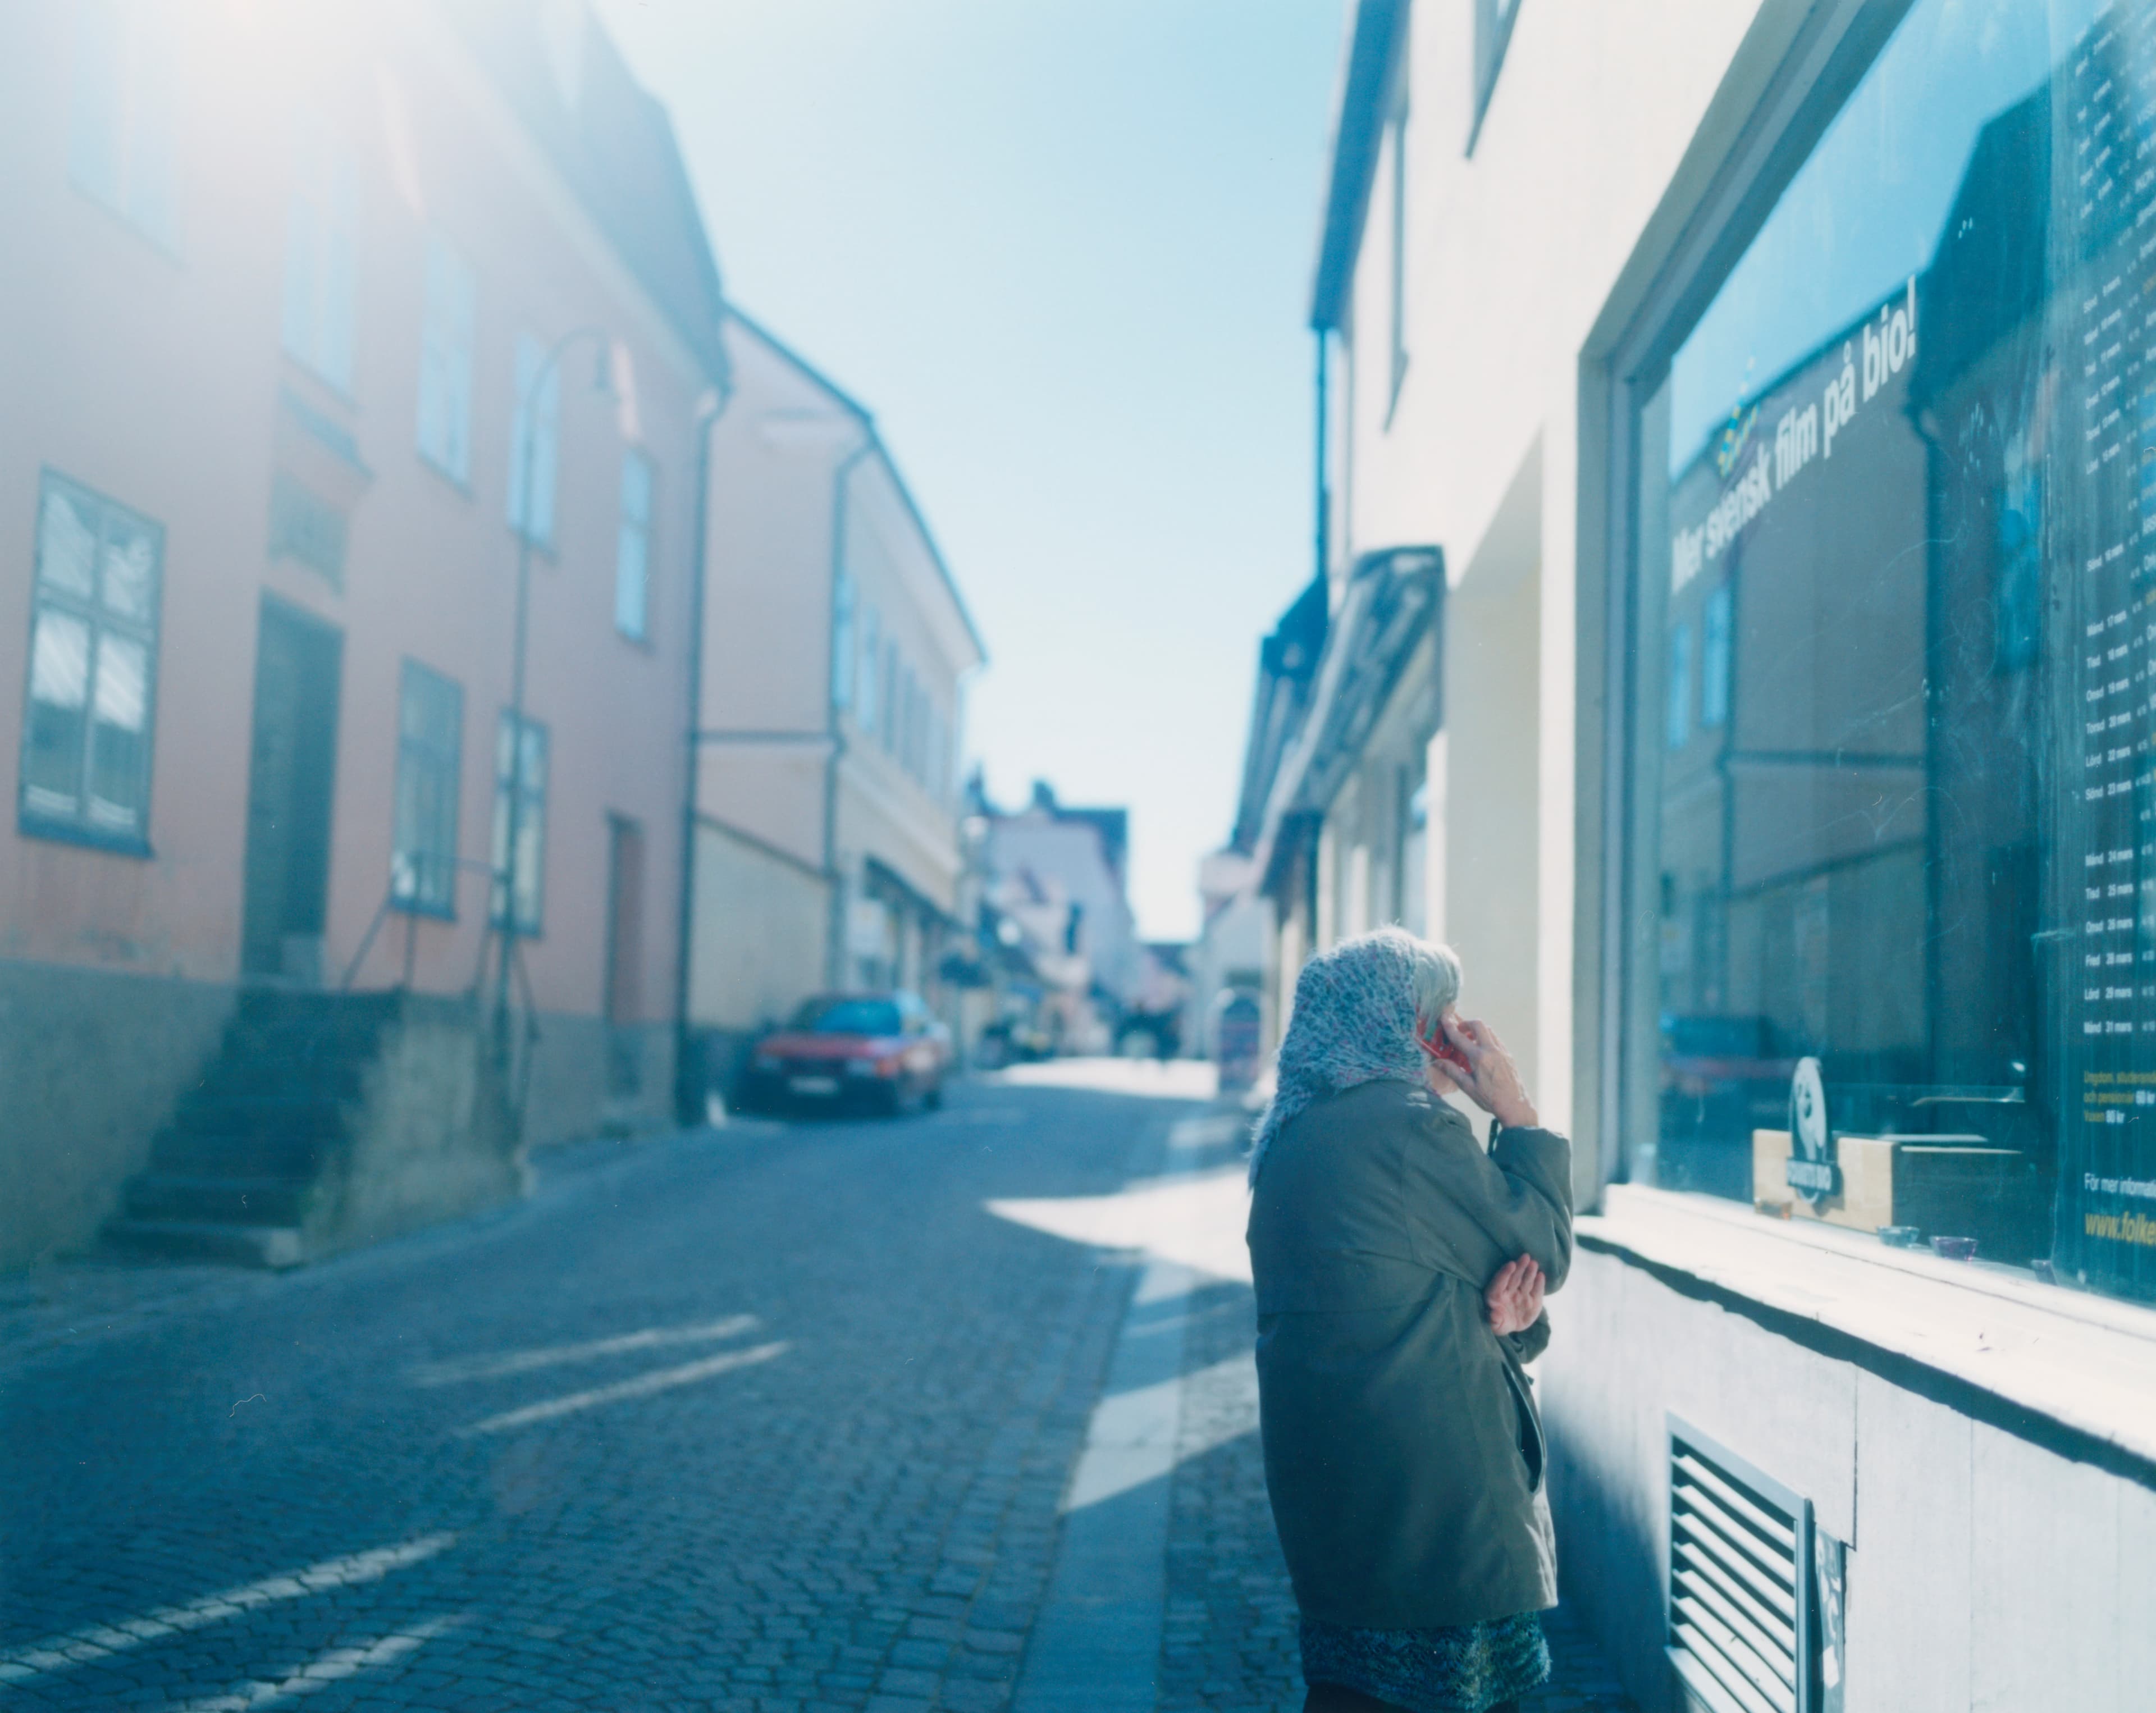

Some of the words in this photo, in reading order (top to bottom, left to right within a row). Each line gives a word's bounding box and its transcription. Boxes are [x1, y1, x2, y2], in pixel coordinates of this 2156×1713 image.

[1706, 442, 1771, 560] svensk
[1775, 401, 1817, 490] film
[1824, 340, 1855, 459] på
[1863, 274, 1916, 403] bio!
[2084, 1172, 2099, 1191] För
[2101, 1178, 2118, 1193] mer
